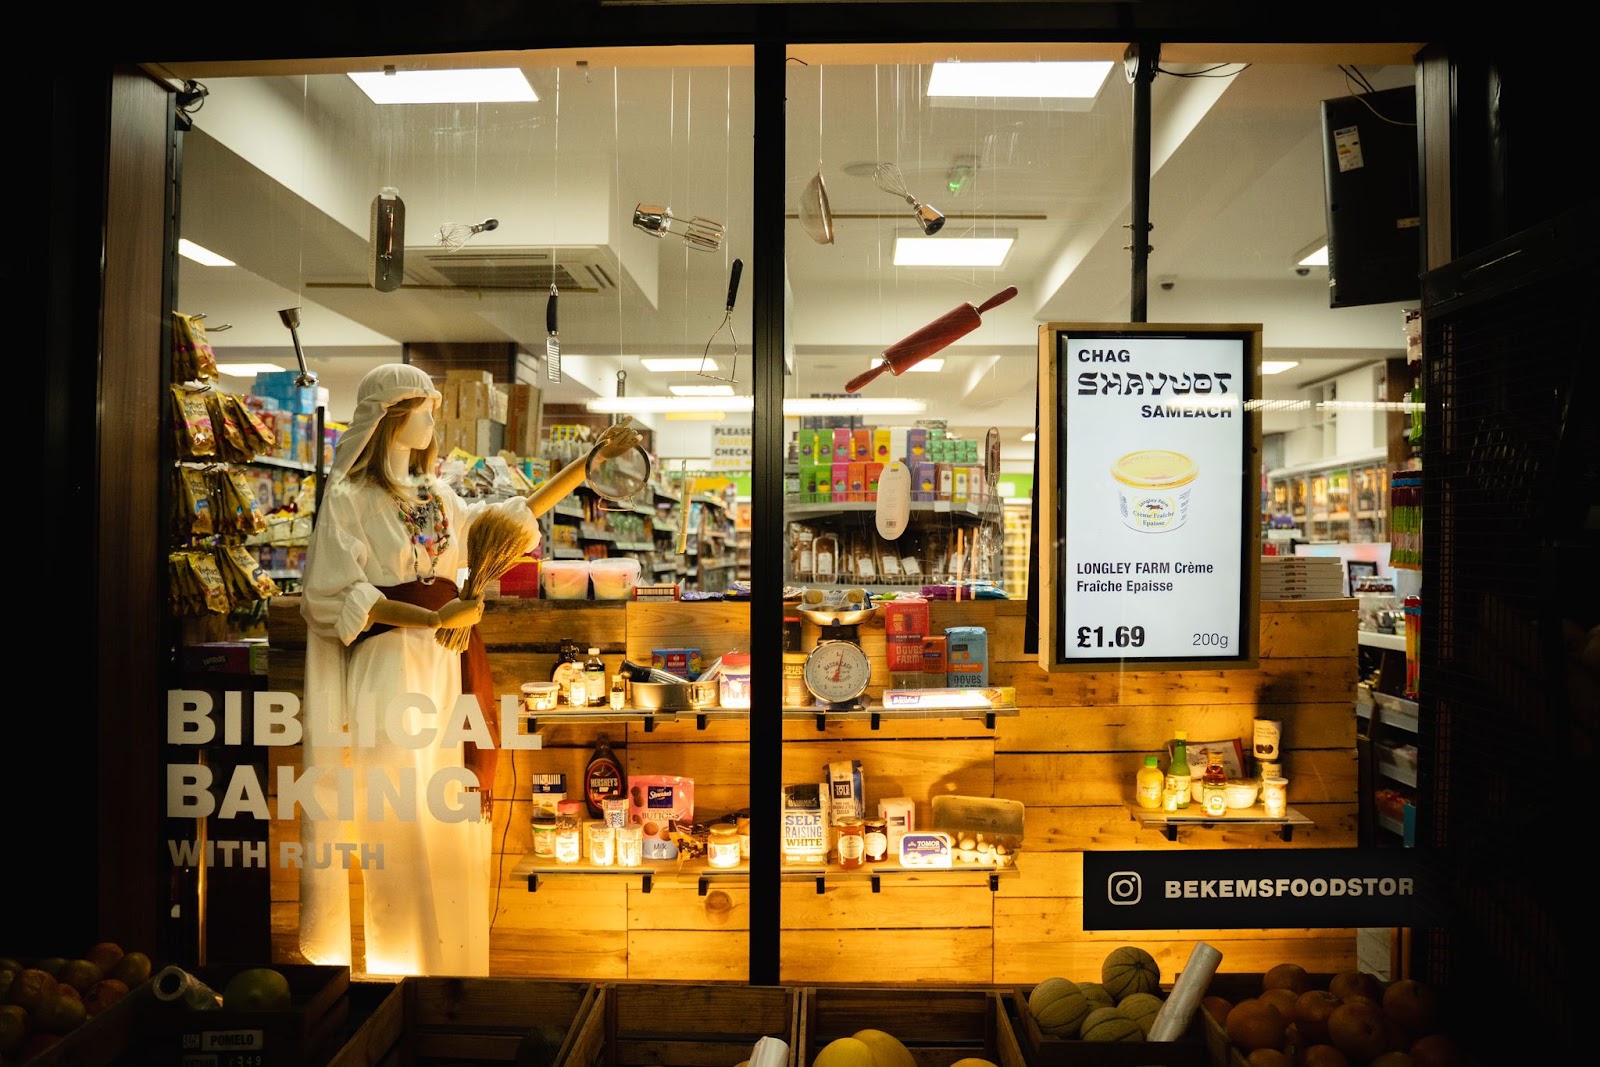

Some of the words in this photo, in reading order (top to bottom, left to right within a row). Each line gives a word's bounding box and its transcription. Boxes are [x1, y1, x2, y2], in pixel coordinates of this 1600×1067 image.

[1078, 349, 1130, 362] CHAG
[1078, 371, 1232, 396] SHAVUOT
[1141, 404, 1232, 418] SAMEACH
[1077, 562, 1131, 574] LONGLEY
[1135, 562, 1170, 574] FARM
[1174, 561, 1213, 574] Crème
[1077, 580, 1122, 592] Fraîche
[1126, 580, 1173, 594] Epaisse
[1077, 625, 1145, 648] £1.69
[1192, 633, 1229, 648] 200g
[953, 675, 981, 684] DOVES
[167, 690, 542, 750] BIBLICAL
[590, 777, 618, 787] HERSHEY'S
[167, 763, 481, 824] BAKING
[642, 812, 680, 820] BUTTONS
[785, 815, 822, 826] SELF
[785, 826, 822, 838] RAISING
[785, 838, 822, 847] WHITE
[168, 840, 267, 868] WITH
[279, 842, 385, 870] RUTH
[1164, 877, 1414, 899] BEKEMSFOODSTOR
[210, 1034, 254, 1046] POMELO
